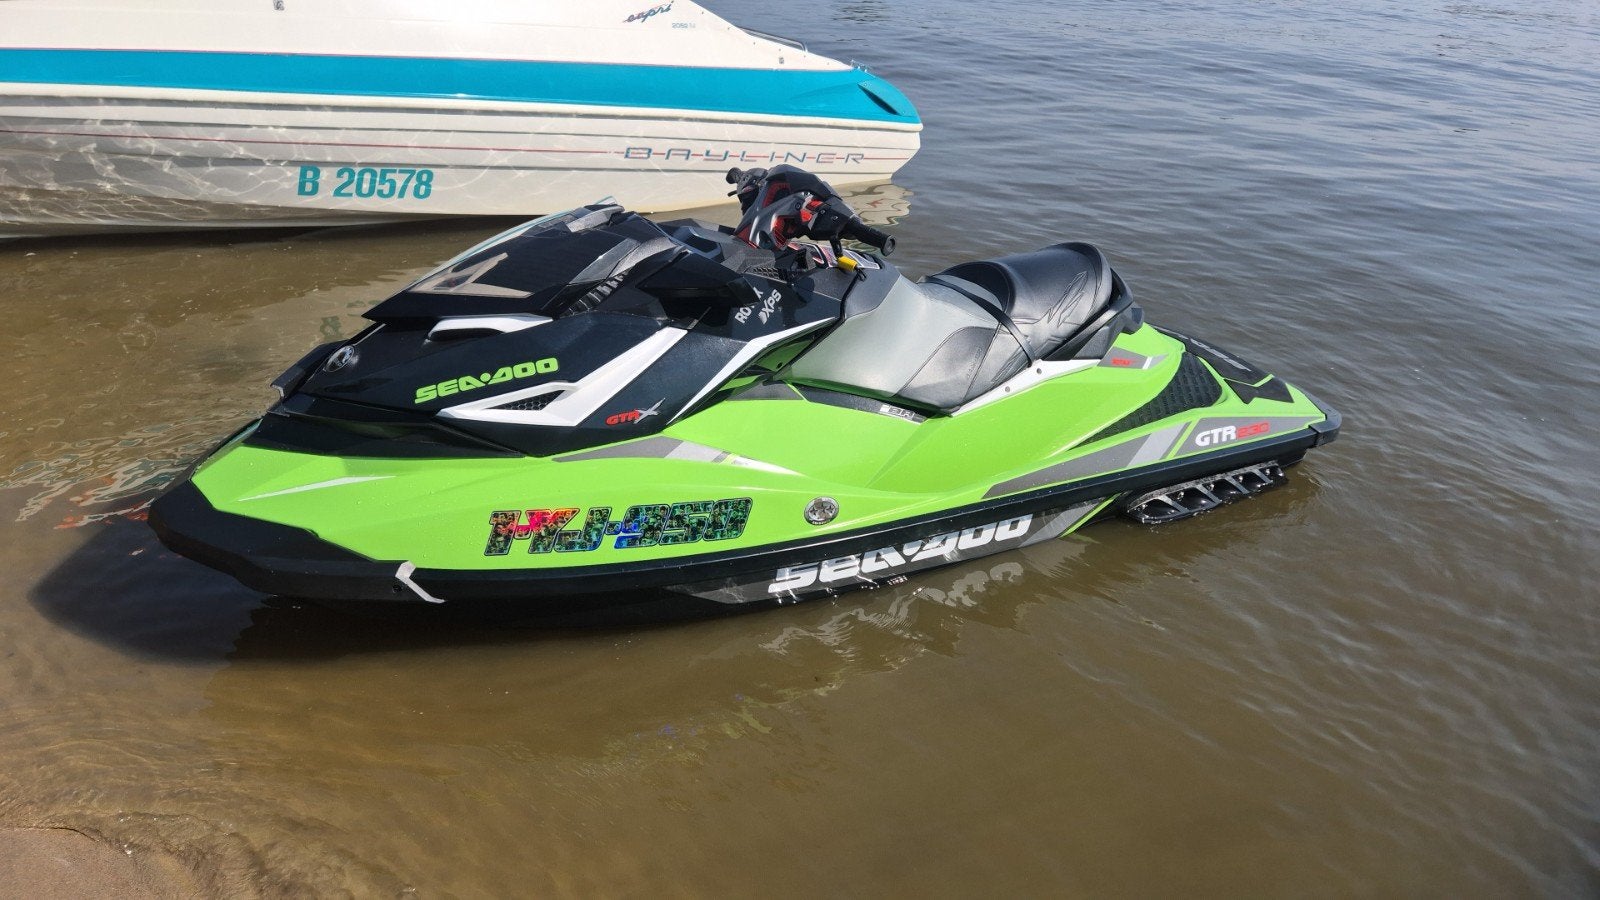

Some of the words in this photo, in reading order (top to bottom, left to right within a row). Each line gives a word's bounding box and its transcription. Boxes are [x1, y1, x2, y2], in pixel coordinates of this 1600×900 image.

[624, 147, 865, 164] BAYLINER
[298, 165, 320, 196] B
[333, 167, 434, 199] 20578
[760, 289, 782, 319] XPS
